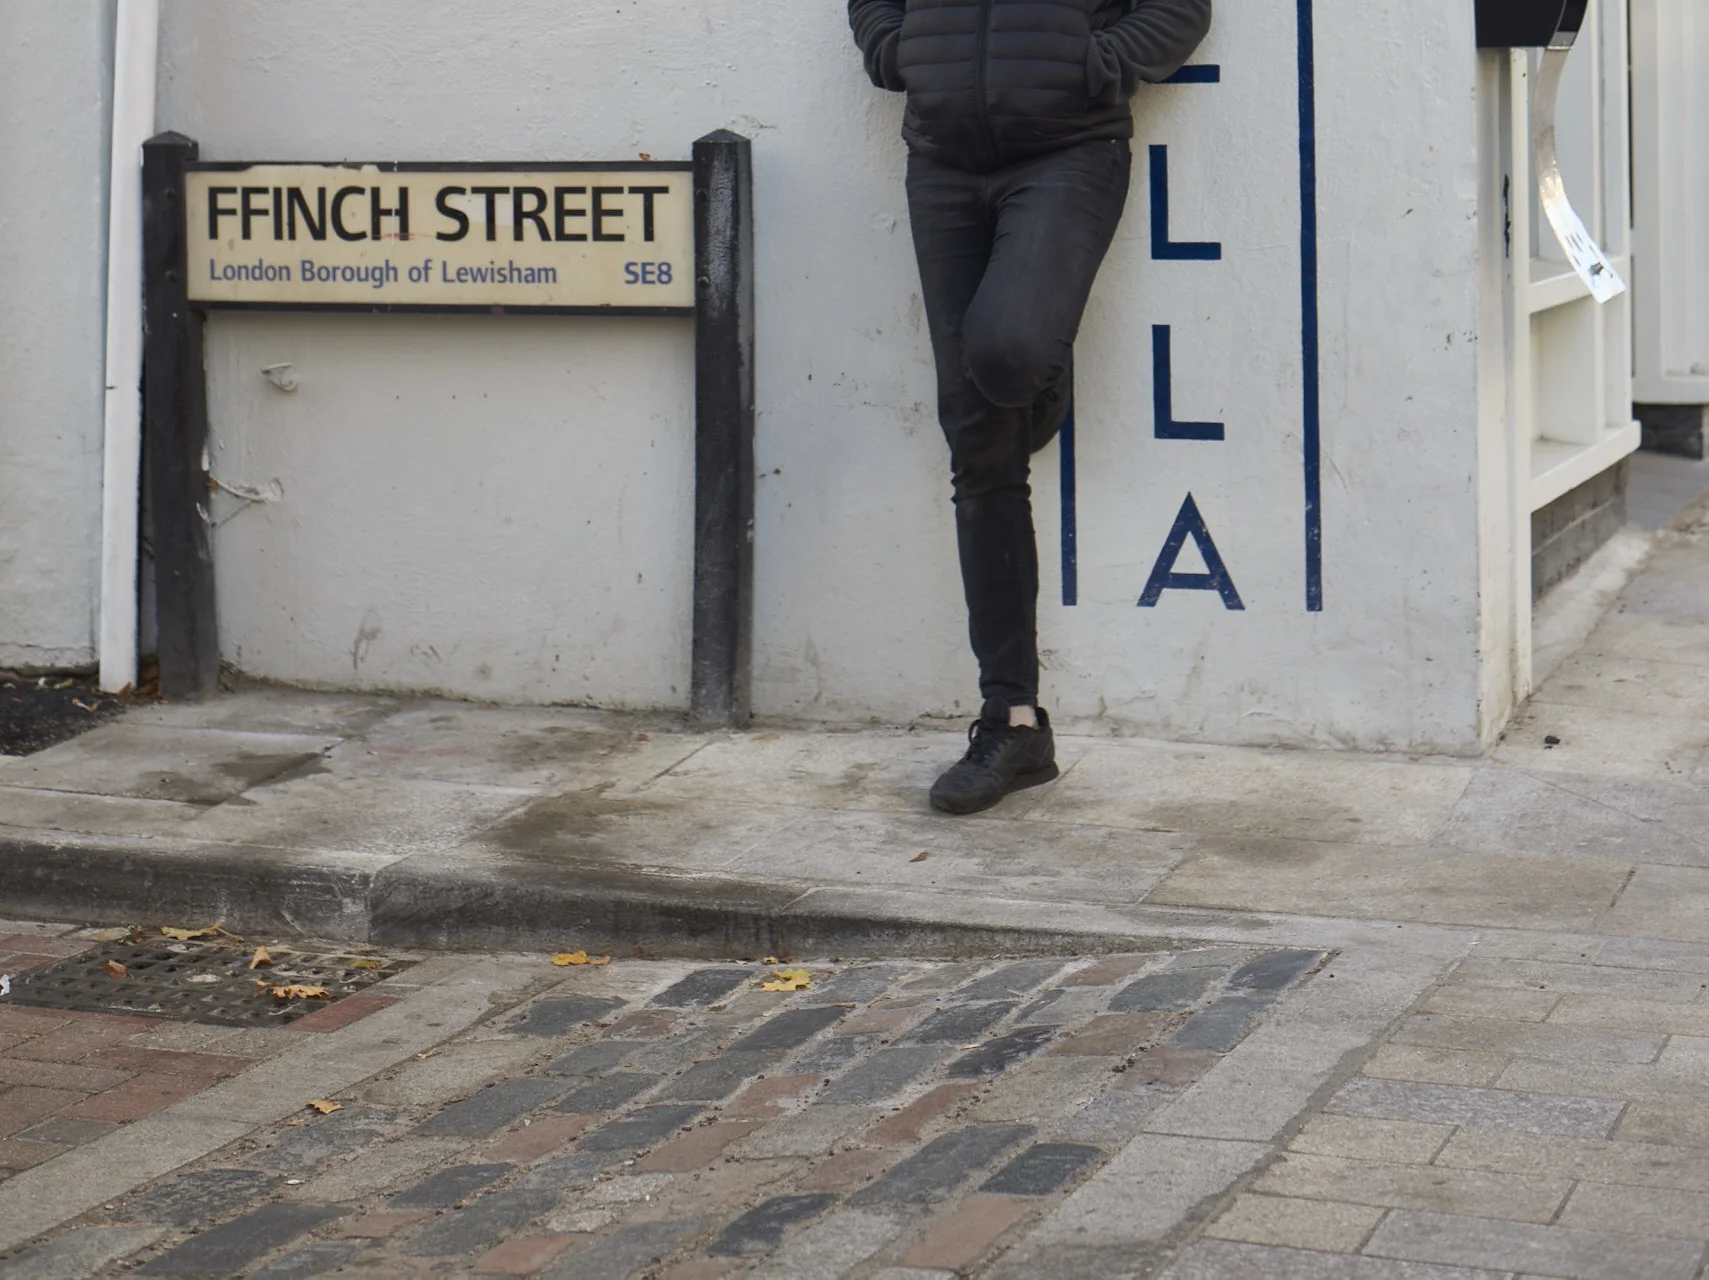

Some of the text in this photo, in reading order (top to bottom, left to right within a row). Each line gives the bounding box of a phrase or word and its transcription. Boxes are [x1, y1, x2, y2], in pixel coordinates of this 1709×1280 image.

[207, 185, 670, 242] FFINCH STREET
[209, 258, 557, 289] London Borough of Lewisham
[623, 261, 673, 285] SE8
